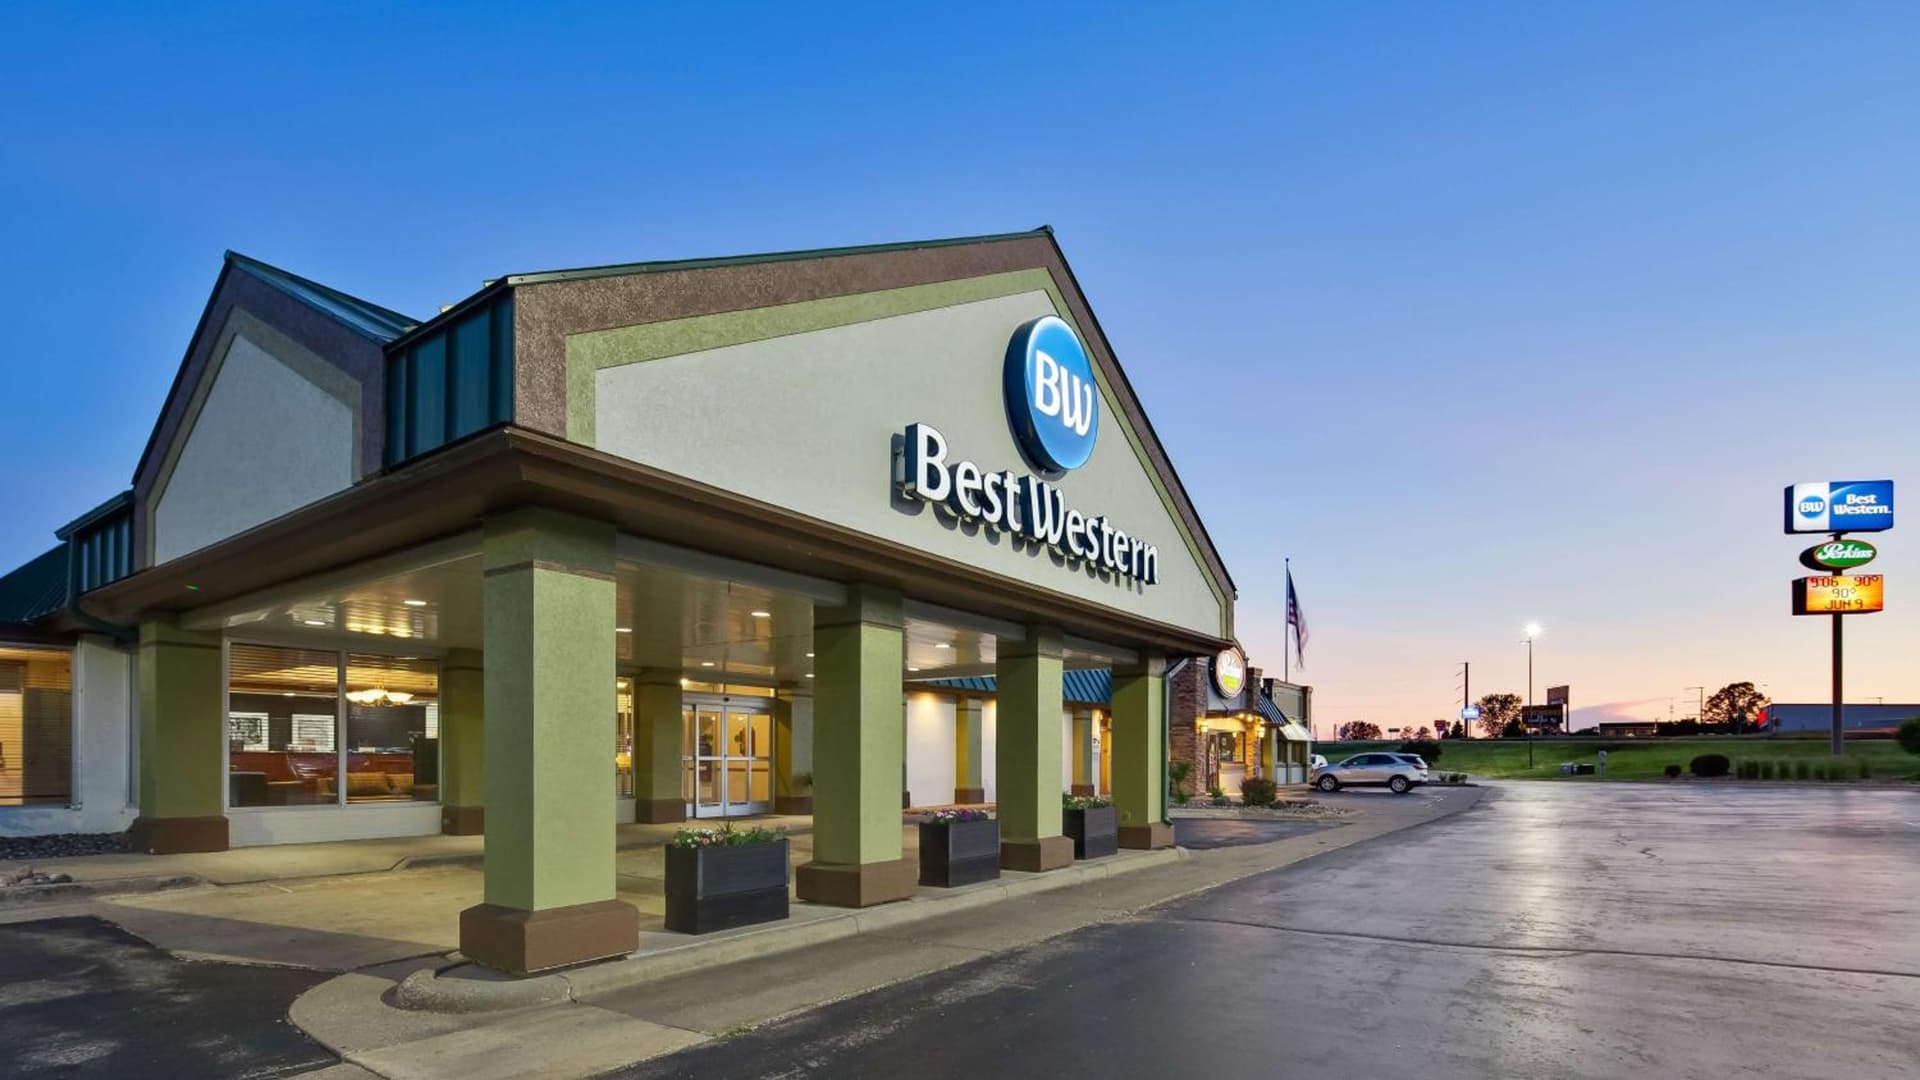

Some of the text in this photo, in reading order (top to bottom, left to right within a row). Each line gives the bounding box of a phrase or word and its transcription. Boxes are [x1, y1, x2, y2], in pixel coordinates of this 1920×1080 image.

[1034, 349, 1093, 437] BW
[911, 422, 1160, 585] Best Western
[1846, 494, 1877, 504] Best
[1800, 502, 1823, 513] BW
[1816, 543, 1874, 560] Perkins
[1825, 599, 1864, 610] JUN 9
